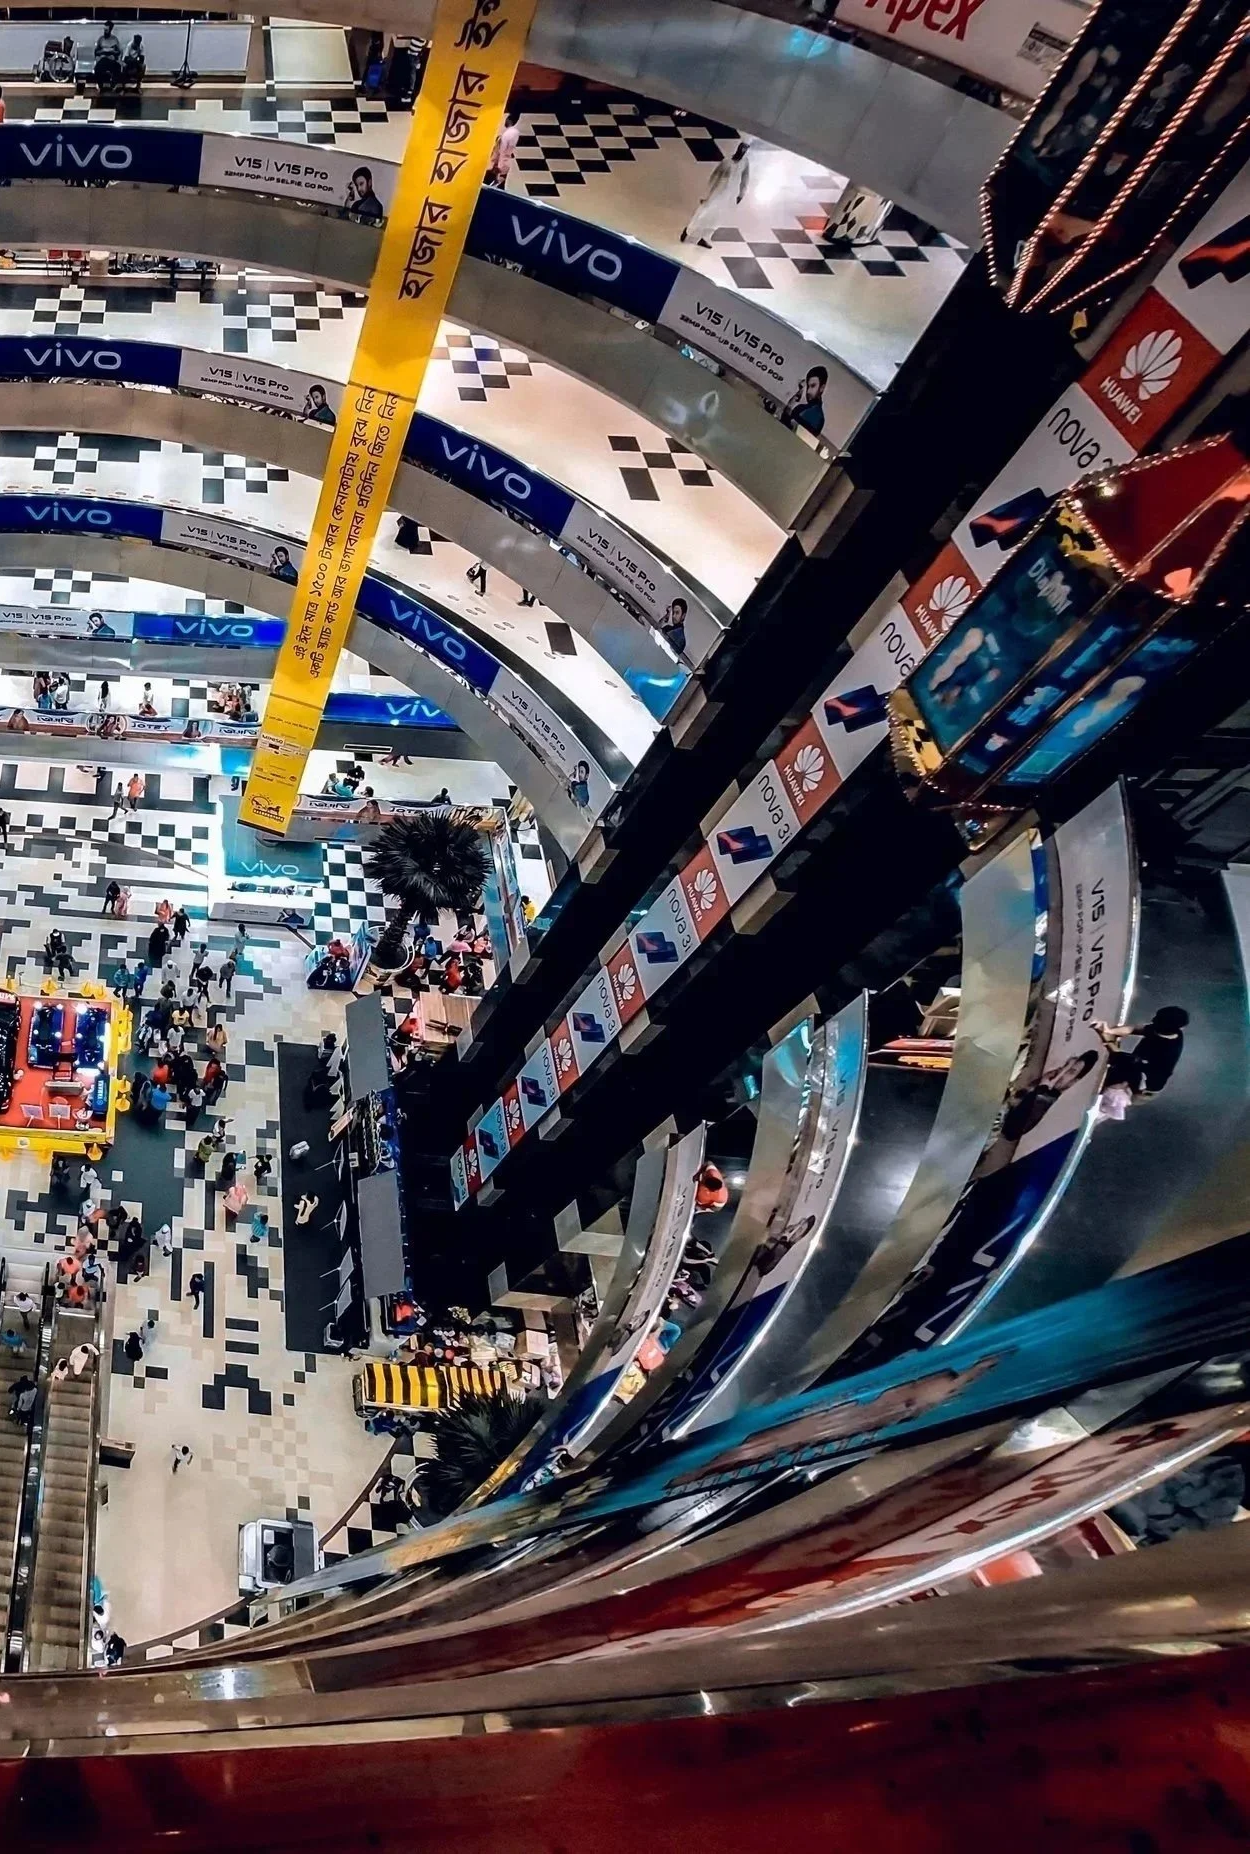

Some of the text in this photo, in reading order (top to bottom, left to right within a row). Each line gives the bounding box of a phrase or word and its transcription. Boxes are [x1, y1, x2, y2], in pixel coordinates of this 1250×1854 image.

[865, 0, 985, 41] pex
[20, 134, 133, 170] vivo
[235, 156, 328, 180] V15 V15 Pro
[397, 201, 452, 301] হাজার
[430, 63, 490, 185] হাজার
[510, 211, 623, 282] vivo
[696, 302, 784, 366] V15 V15 Pro
[23, 345, 122, 370] vivo
[209, 367, 232, 378] V15
[242, 373, 266, 385] V15
[269, 379, 289, 391] Pro
[355, 385, 377, 414] নিন
[378, 392, 400, 420] নিন
[1100, 376, 1143, 425] HUAWEI
[350, 418, 368, 447] বুঝে
[367, 423, 390, 458] জিতে
[1047, 407, 1101, 469] nova
[440, 432, 532, 500] vivo
[356, 461, 380, 508] প্রতিদিন
[25, 502, 113, 526] vivo
[187, 525, 208, 536] V15
[216, 532, 237, 544] V15
[239, 539, 258, 550] Pro
[318, 523, 341, 560] টাকার
[588, 528, 656, 592] V15 V15 Pro
[309, 563, 328, 597] ১৫০০
[331, 575, 348, 599] আর
[175, 617, 254, 639] vivo
[304, 601, 320, 623] মাত্র
[324, 600, 340, 625] কার্ড
[296, 625, 313, 645] ঈদে
[389, 600, 467, 662] vivo
[293, 646, 307, 660] এই
[310, 651, 325, 678] একটি
[879, 622, 916, 677] nova
[386, 700, 441, 717] viv
[511, 690, 566, 751] V15 V15 Pro
[783, 765, 805, 807] HUAWEI
[758, 774, 793, 845] nova 3i
[241, 860, 299, 875] vivo
[667, 888, 693, 952] nova 3i
[686, 882, 702, 922] HUAWEI
[1082, 877, 1105, 1022] V15 V15 Pro
[597, 976, 613, 1018] nova
